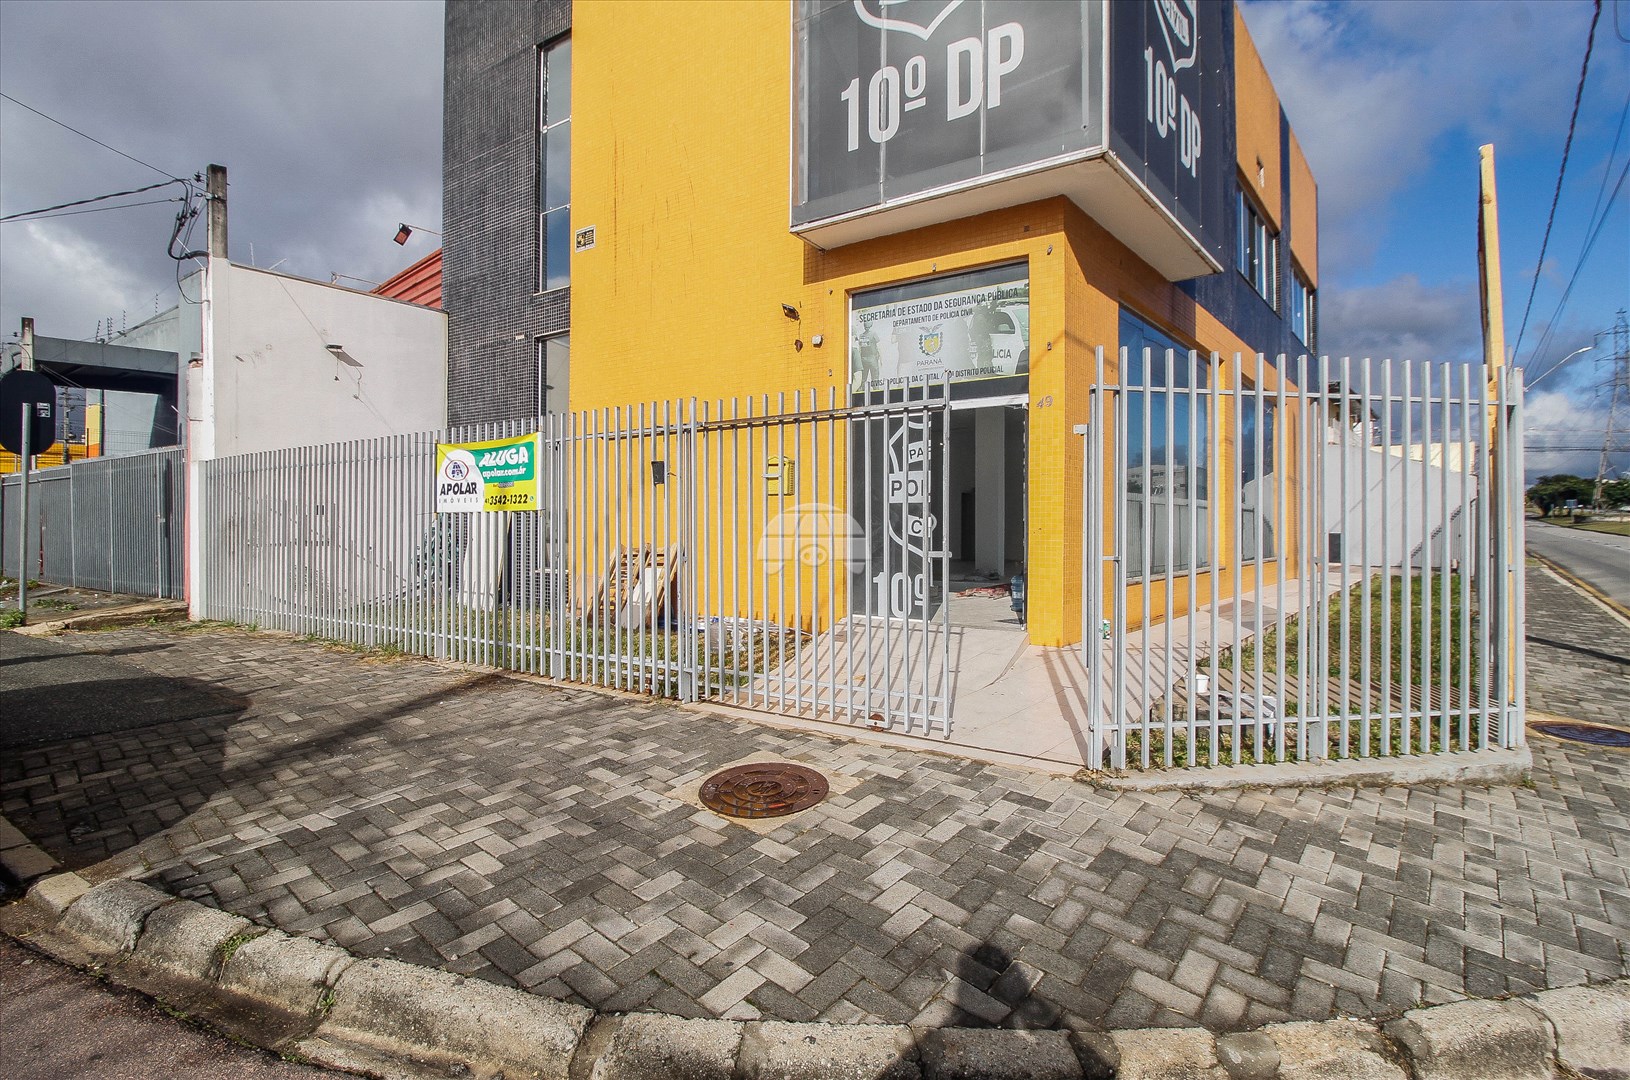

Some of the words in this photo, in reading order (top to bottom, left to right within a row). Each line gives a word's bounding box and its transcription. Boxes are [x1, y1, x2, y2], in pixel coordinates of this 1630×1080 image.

[947, 21, 1025, 121] DP
[1180, 94, 1202, 178] DP
[859, 308, 896, 323] SECRETARIA
[897, 307, 906, 317] DE
[907, 302, 932, 314] ESTADO
[933, 301, 943, 310] DA
[944, 293, 986, 309] SEGURANÇA
[892, 315, 932, 328] DEPARTAMENTO
[932, 313, 938, 321] DE
[960, 308, 973, 317] CIVIL
[870, 379, 887, 387] DIVIS
[889, 376, 910, 385] POLICL
[911, 375, 918, 383] DA
[919, 373, 939, 382] CITAL
[955, 367, 979, 377] DISTRITO
[980, 365, 1004, 374] POLICIAL
[1036, 395, 1054, 409] 49
[478, 446, 529, 467] ALUGA
[482, 465, 527, 479] apolar.com.br
[440, 482, 478, 495] APOLAR
[489, 493, 528, 506] 3542-1322
